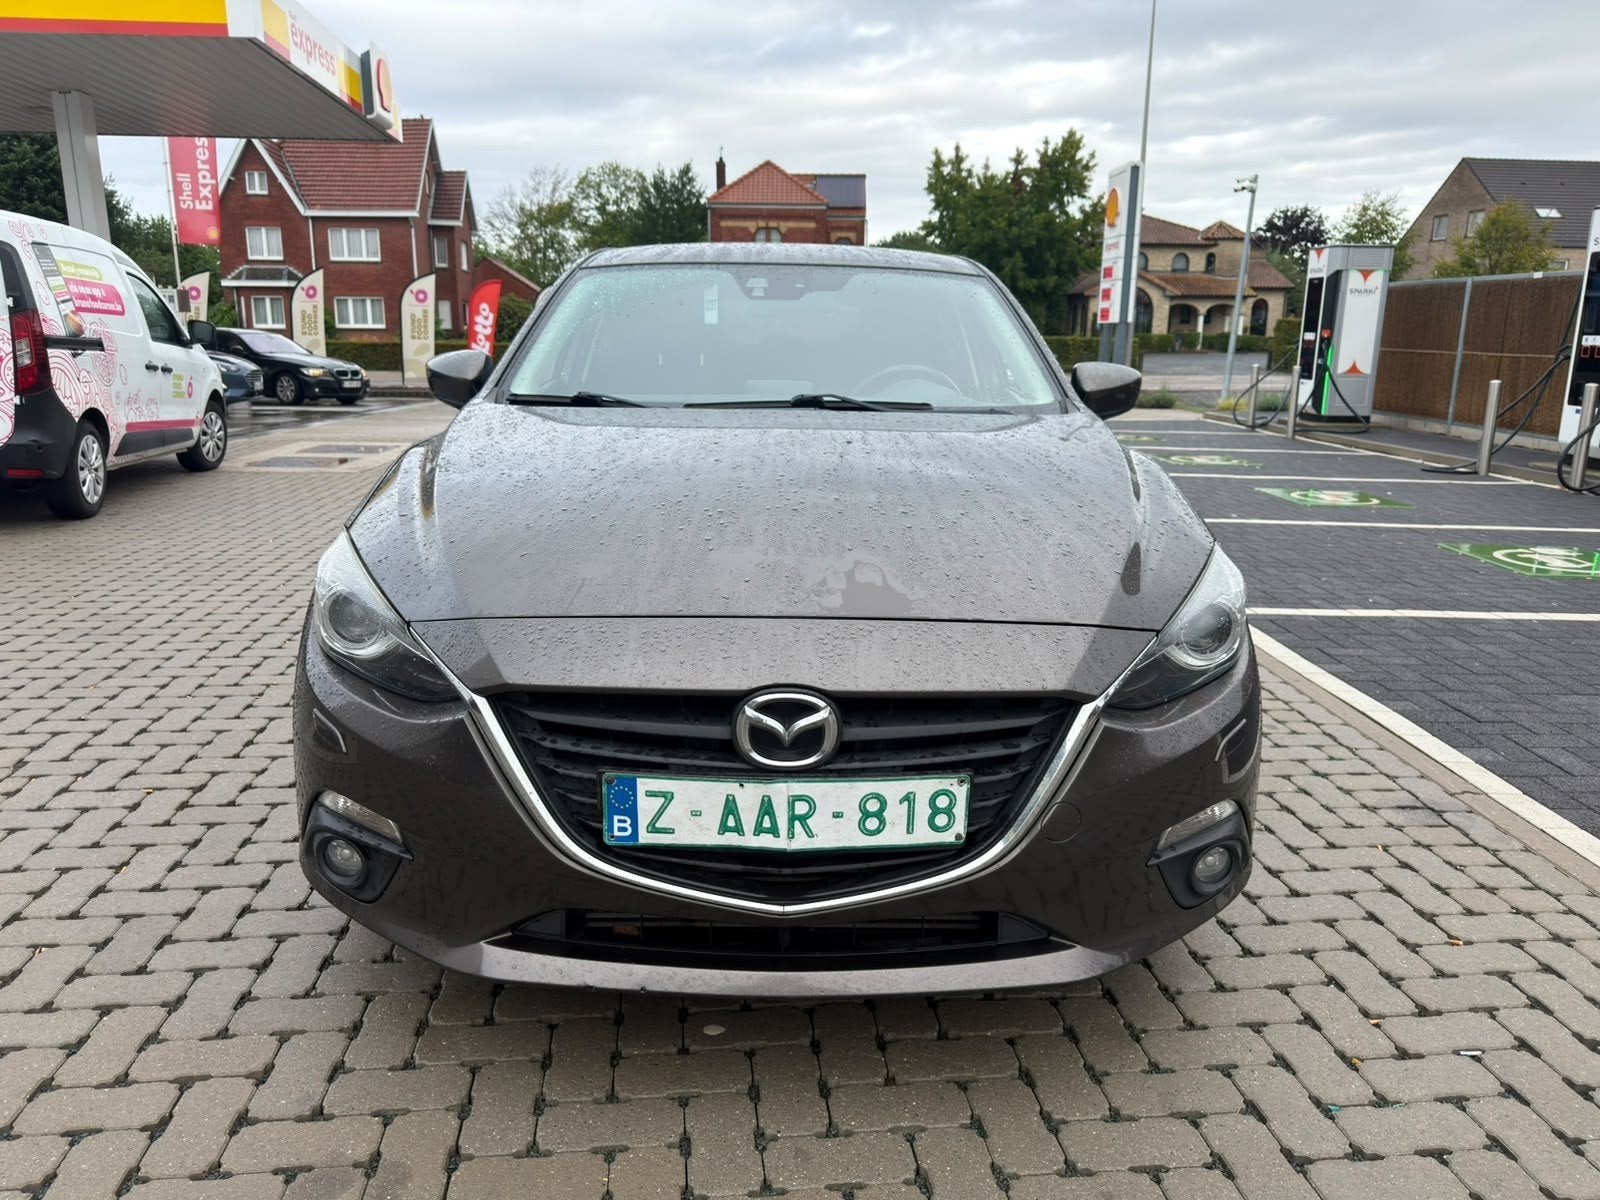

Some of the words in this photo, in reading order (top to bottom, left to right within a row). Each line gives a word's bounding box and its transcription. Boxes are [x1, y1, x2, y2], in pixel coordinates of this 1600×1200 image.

[290, 22, 336, 76] express
[176, 172, 193, 209] Shell
[612, 815, 632, 836] B
